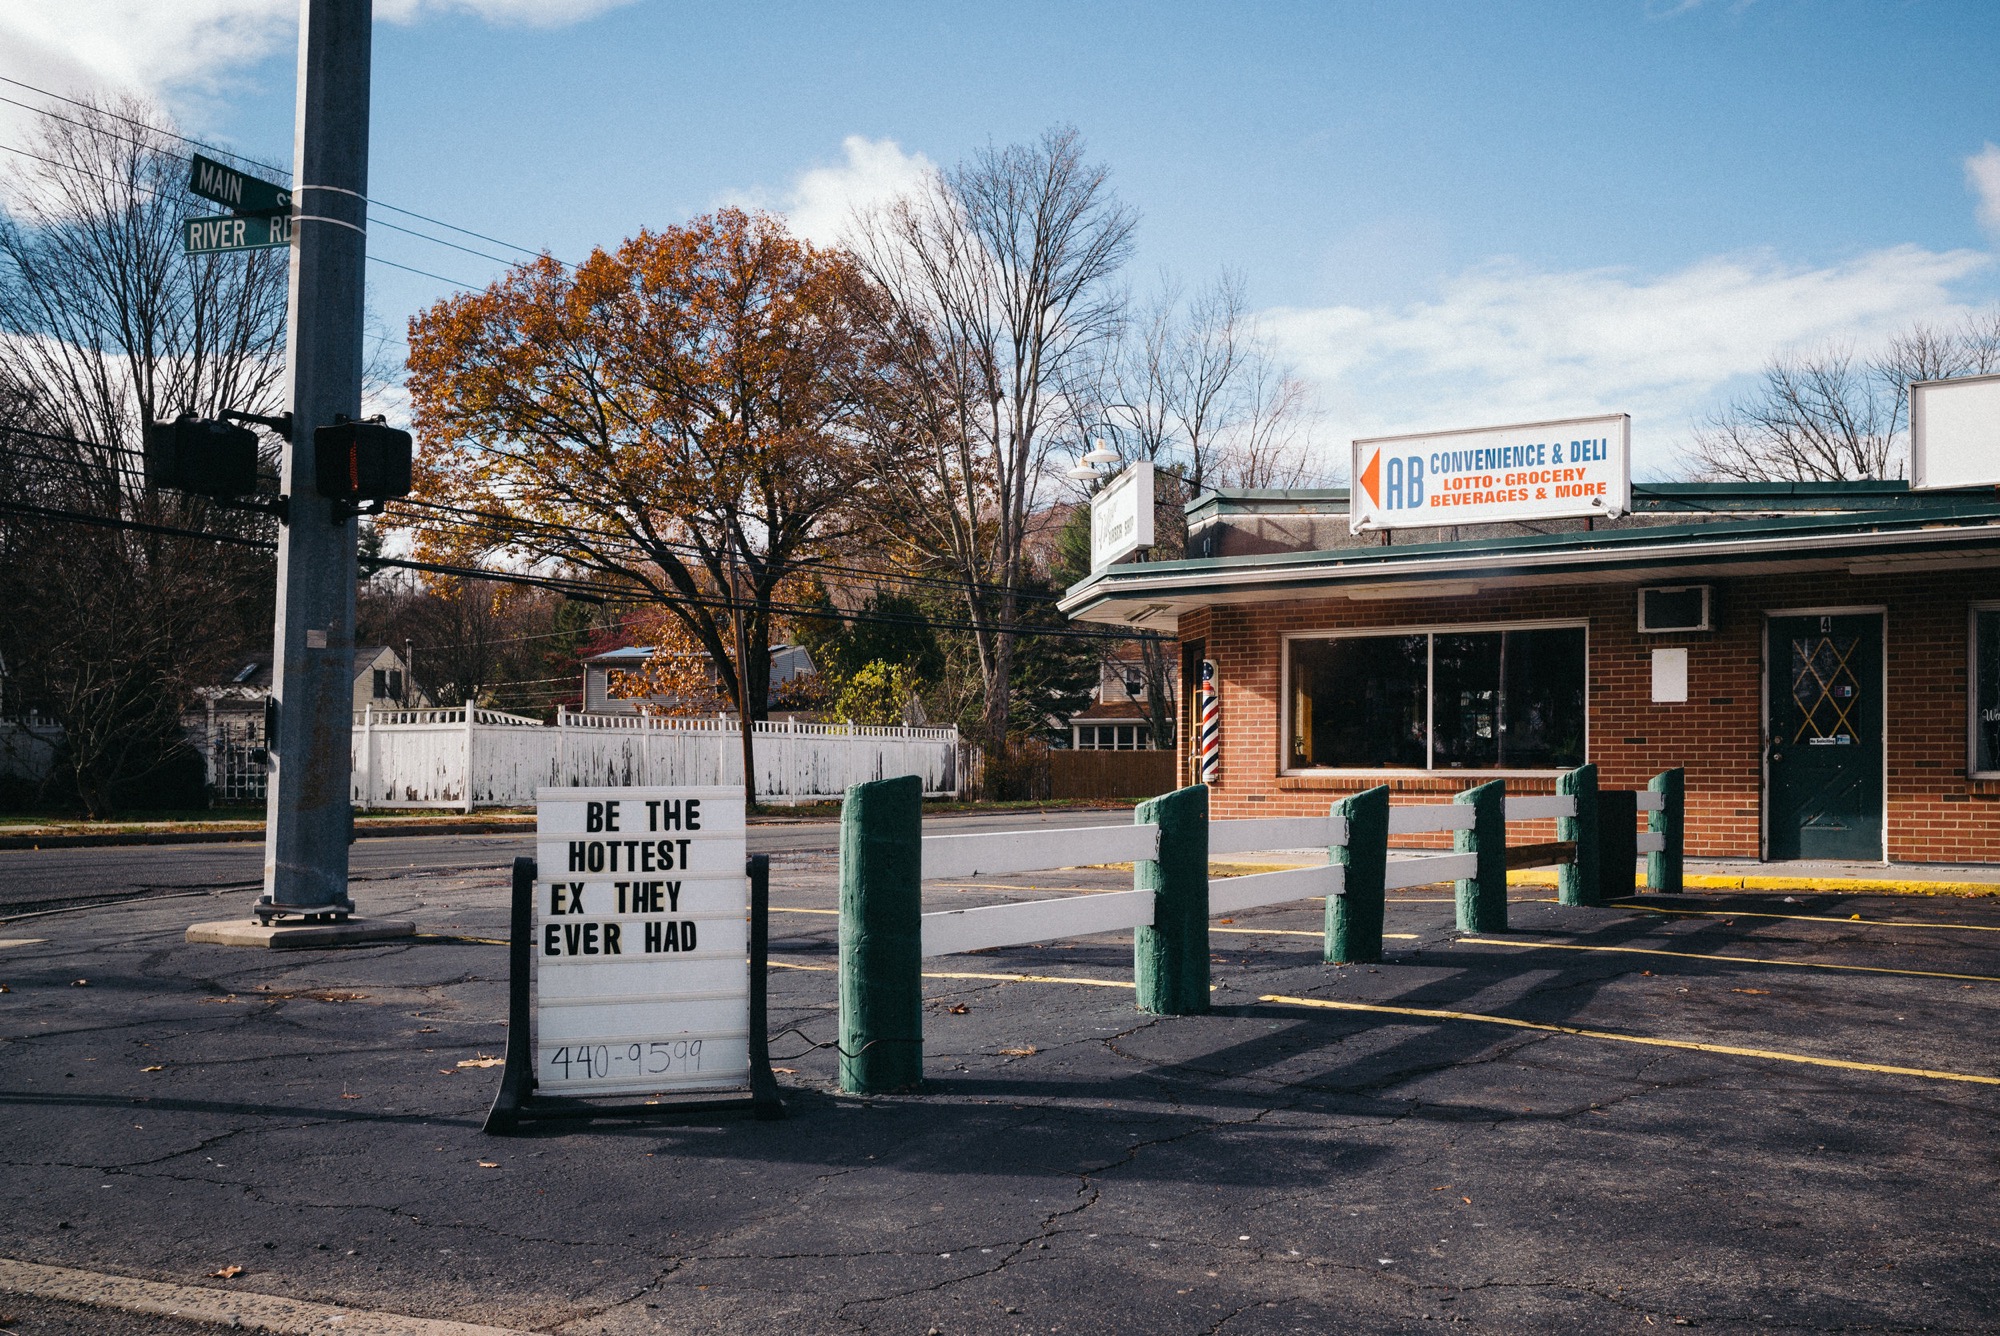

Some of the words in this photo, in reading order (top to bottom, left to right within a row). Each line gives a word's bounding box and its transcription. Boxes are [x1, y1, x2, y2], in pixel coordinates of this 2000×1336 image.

[199, 161, 243, 205] MAIN
[276, 192, 292, 207] S
[189, 219, 246, 250] RIVER
[1386, 455, 1424, 511] AB
[1430, 443, 1546, 475] CONVENIENCE
[1551, 442, 1564, 465] &
[1570, 438, 1608, 463] DELI
[1443, 475, 1493, 491] LOTTO
[1505, 467, 1586, 487] GROCERY
[1430, 487, 1529, 508] BEVERAGES
[1535, 486, 1548, 501] &
[1555, 481, 1607, 499] MORE
[1821, 616, 1831, 633] 4
[586, 801, 620, 833] BE
[645, 799, 701, 832] THE
[568, 839, 691, 872] HOTTEST
[551, 881, 585, 915] EX
[614, 881, 682, 914] THEY
[545, 922, 621, 956] EVER
[644, 920, 697, 954] HAD
[551, 1040, 703, 1080] 440-9599
